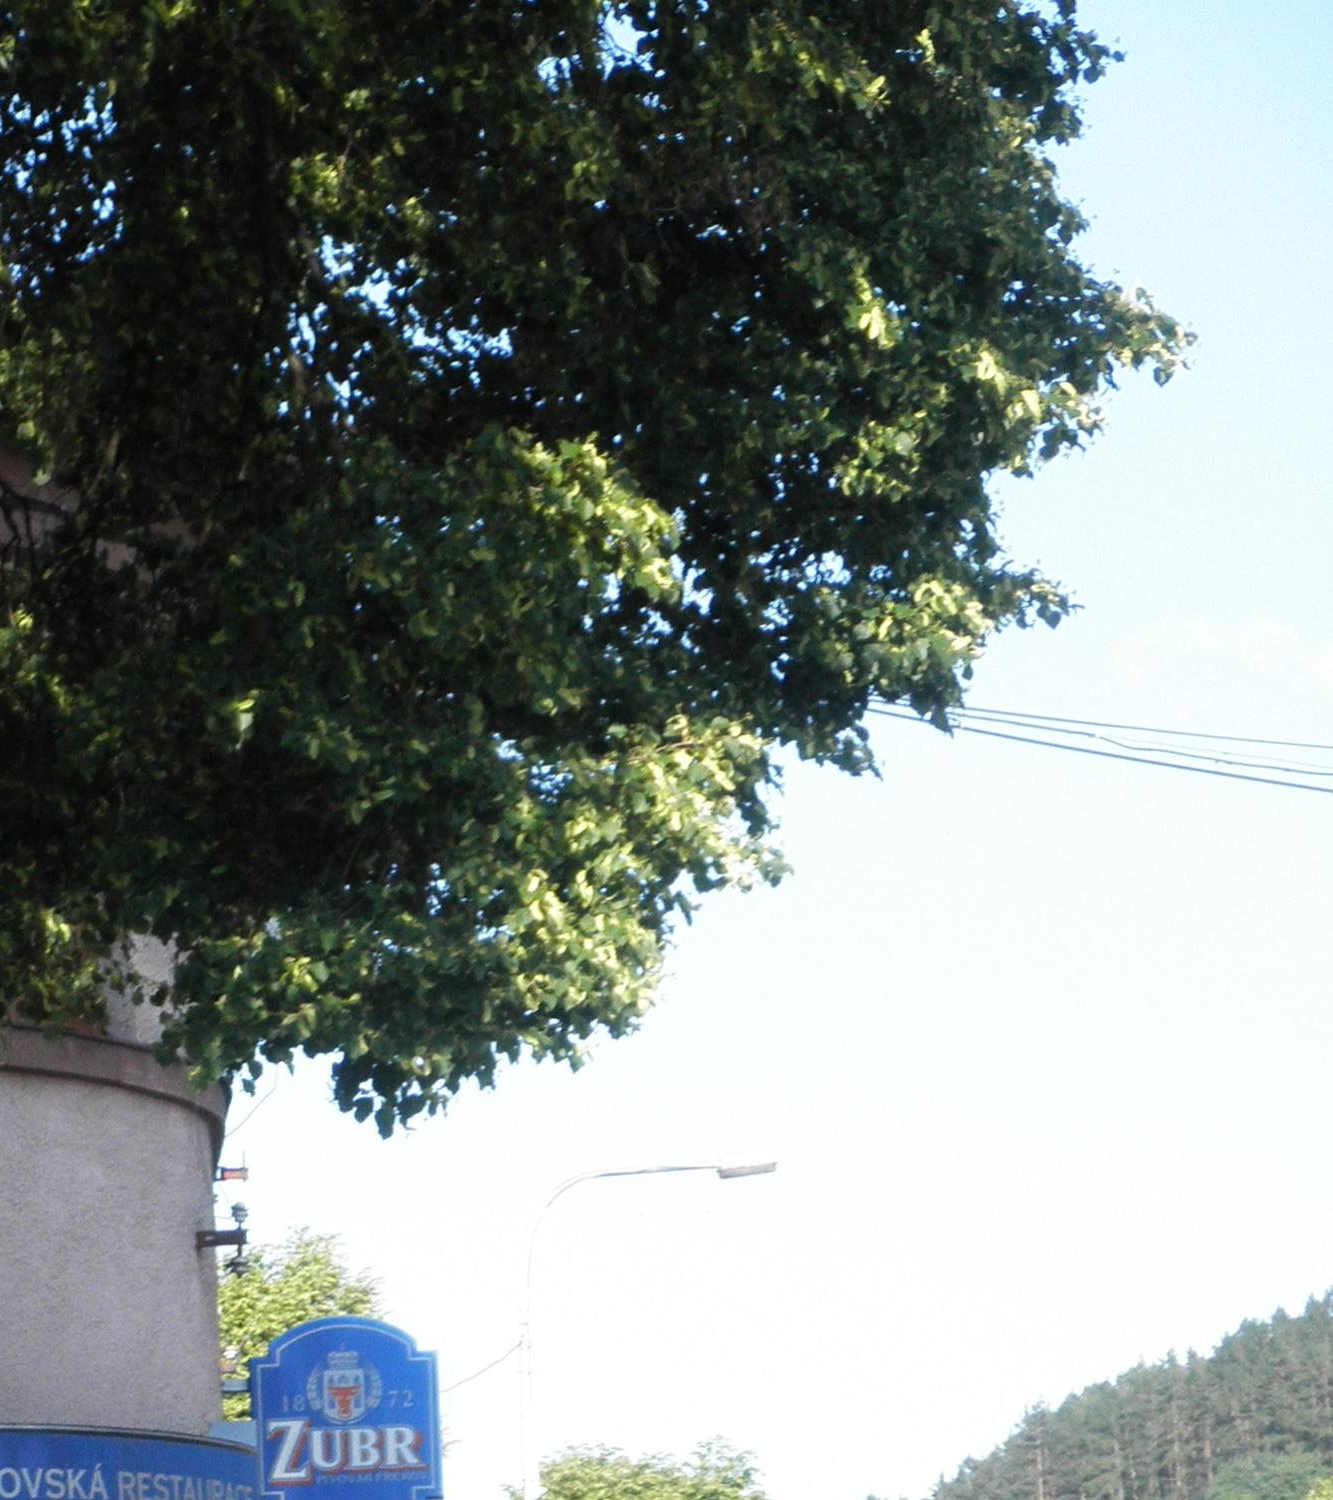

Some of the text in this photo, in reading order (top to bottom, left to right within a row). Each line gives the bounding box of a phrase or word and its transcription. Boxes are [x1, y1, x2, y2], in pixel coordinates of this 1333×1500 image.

[283, 1390, 414, 1412] 18 72
[267, 1418, 427, 1487] ZUBR
